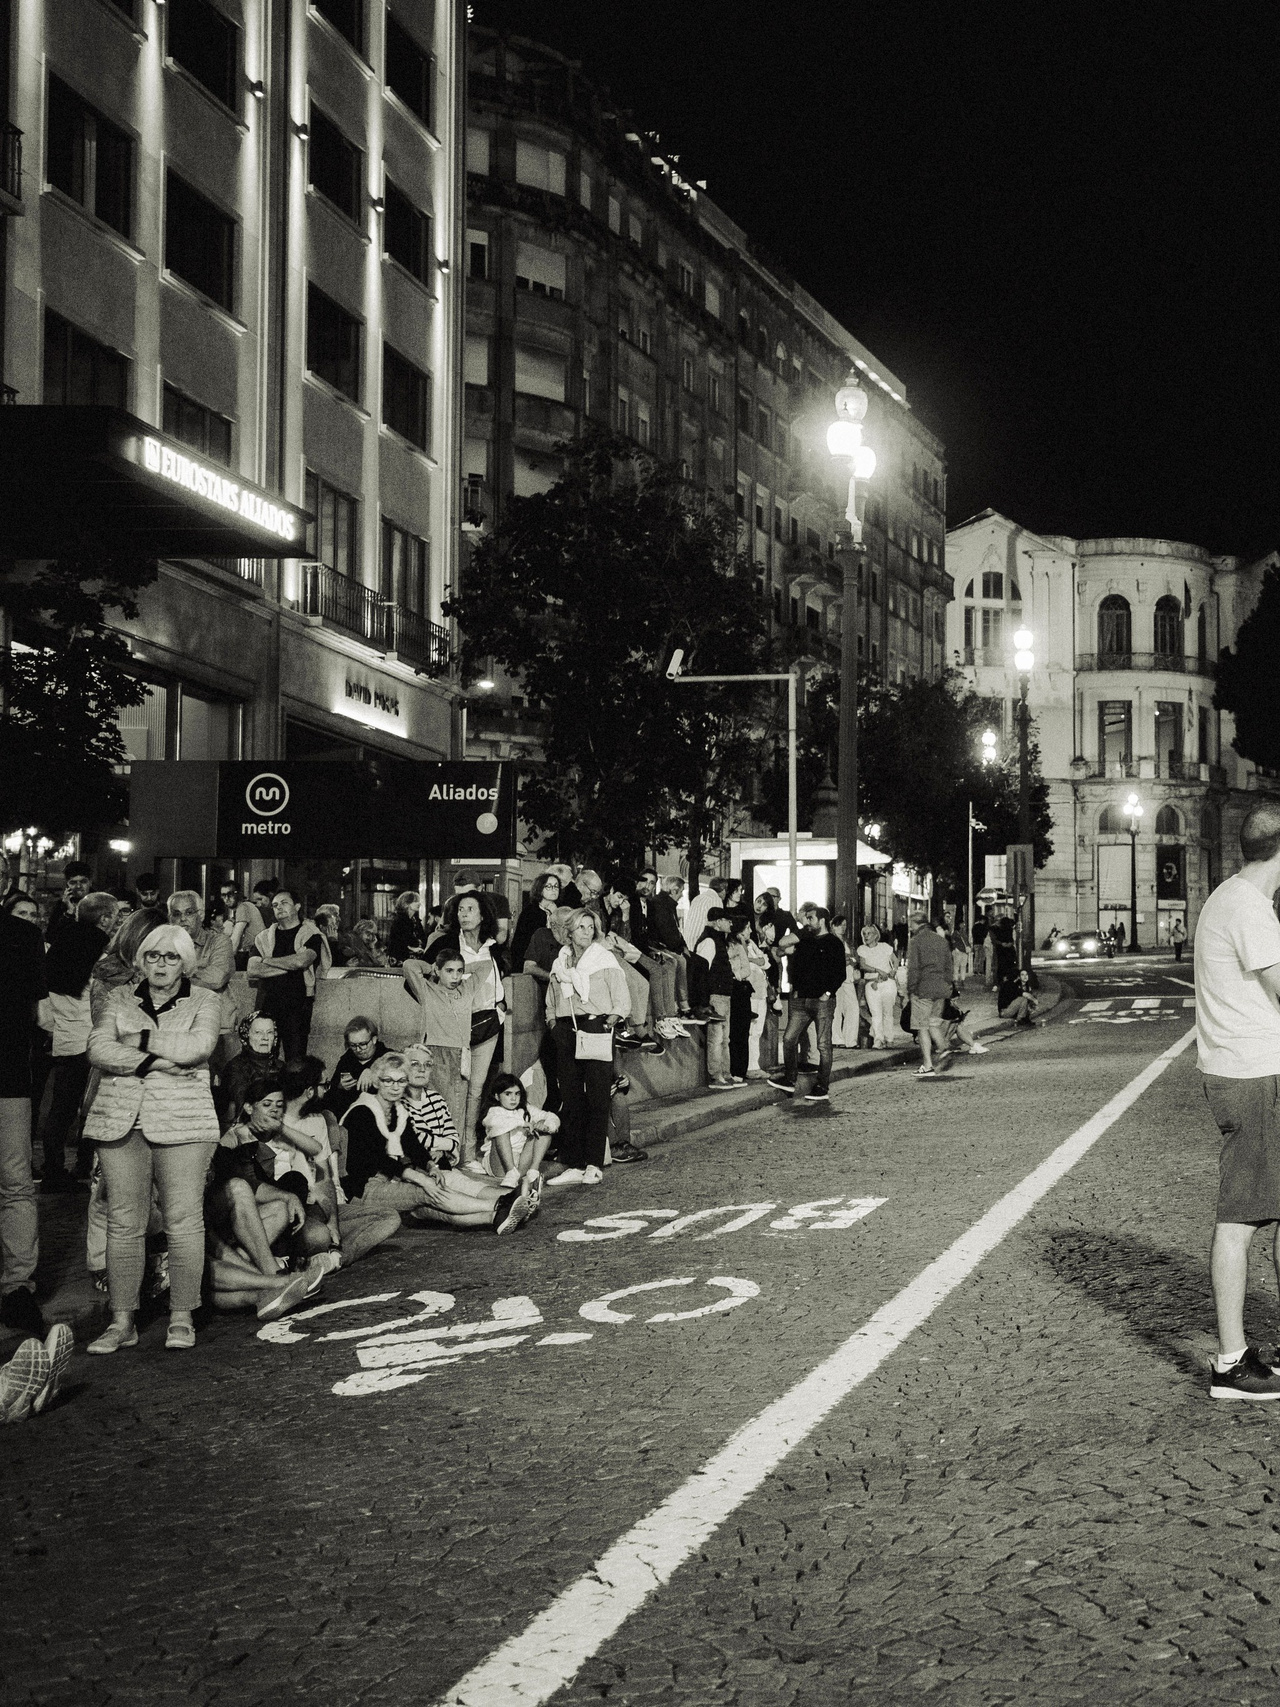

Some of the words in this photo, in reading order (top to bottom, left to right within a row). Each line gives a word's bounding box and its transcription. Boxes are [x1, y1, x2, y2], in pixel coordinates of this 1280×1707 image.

[160, 446, 240, 512] EUROSTARS
[238, 490, 296, 541] ALIADOS
[428, 783, 499, 801] Aliados
[241, 820, 291, 835] metro
[556, 1196, 890, 1242] BUS
